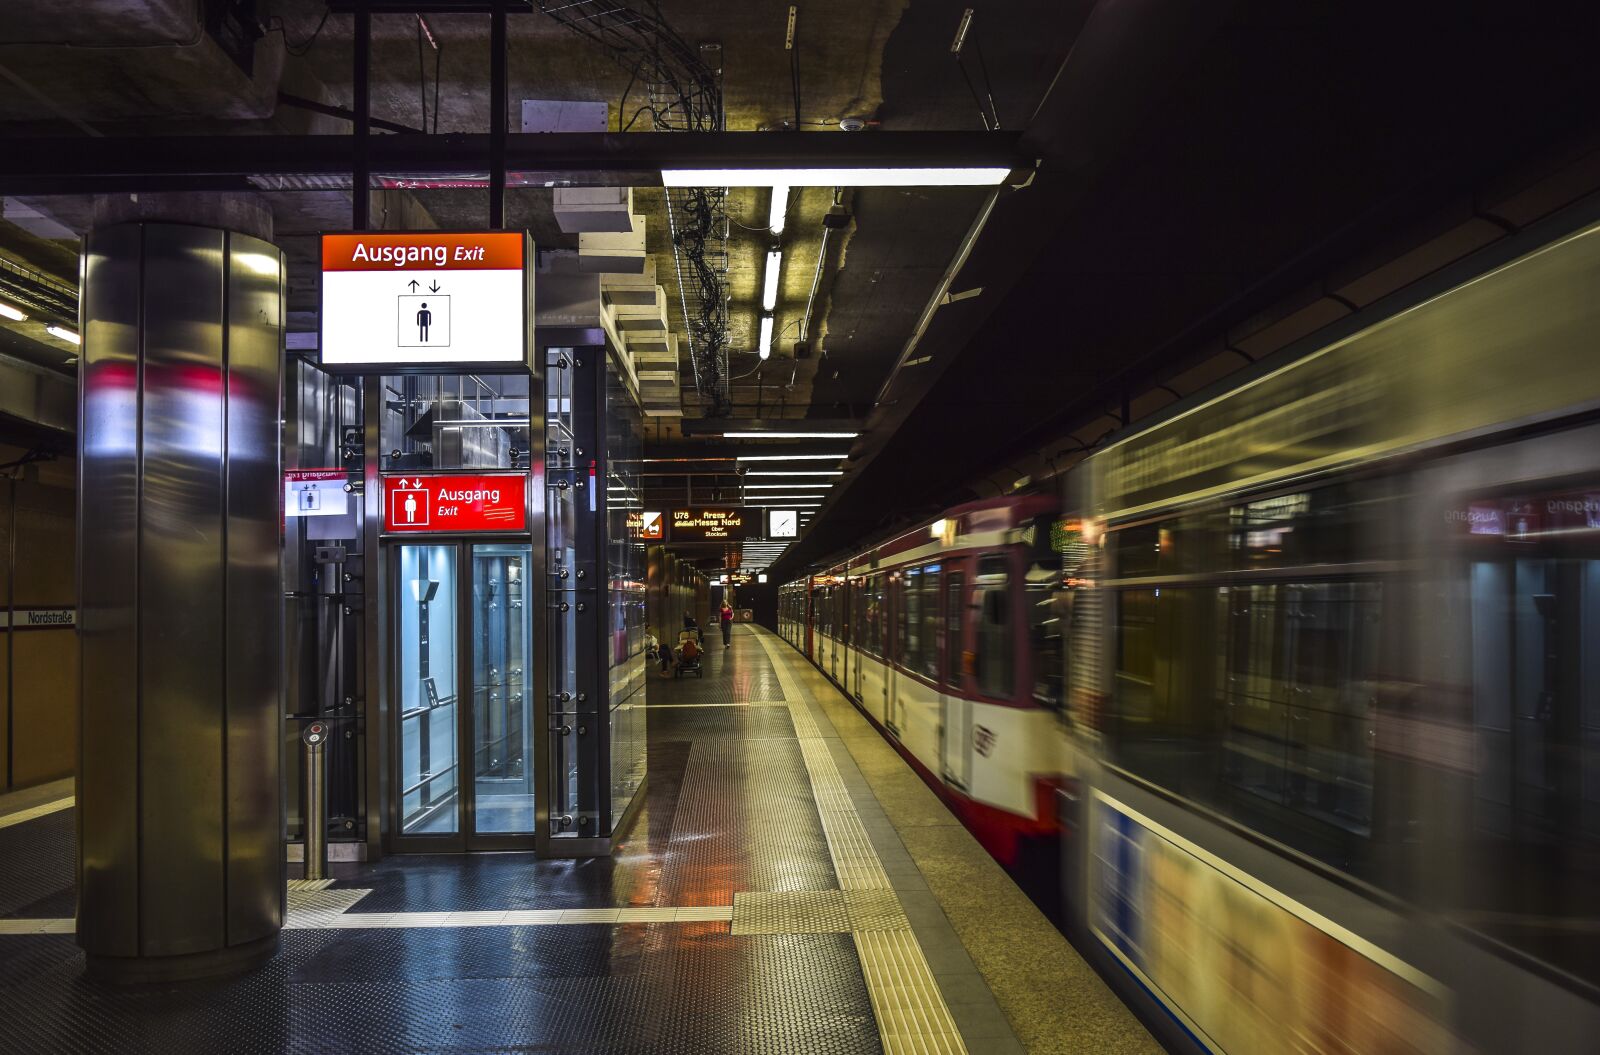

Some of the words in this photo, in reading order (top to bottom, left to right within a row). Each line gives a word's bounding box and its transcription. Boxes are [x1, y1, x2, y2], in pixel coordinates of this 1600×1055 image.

[352, 243, 447, 266] Ausgang
[453, 246, 485, 261] Exit
[438, 488, 500, 503] Ausgang
[438, 506, 458, 516] Exit
[703, 511, 726, 519] Arena
[721, 518, 741, 526] Nord
[28, 611, 72, 624] Nordstraße
